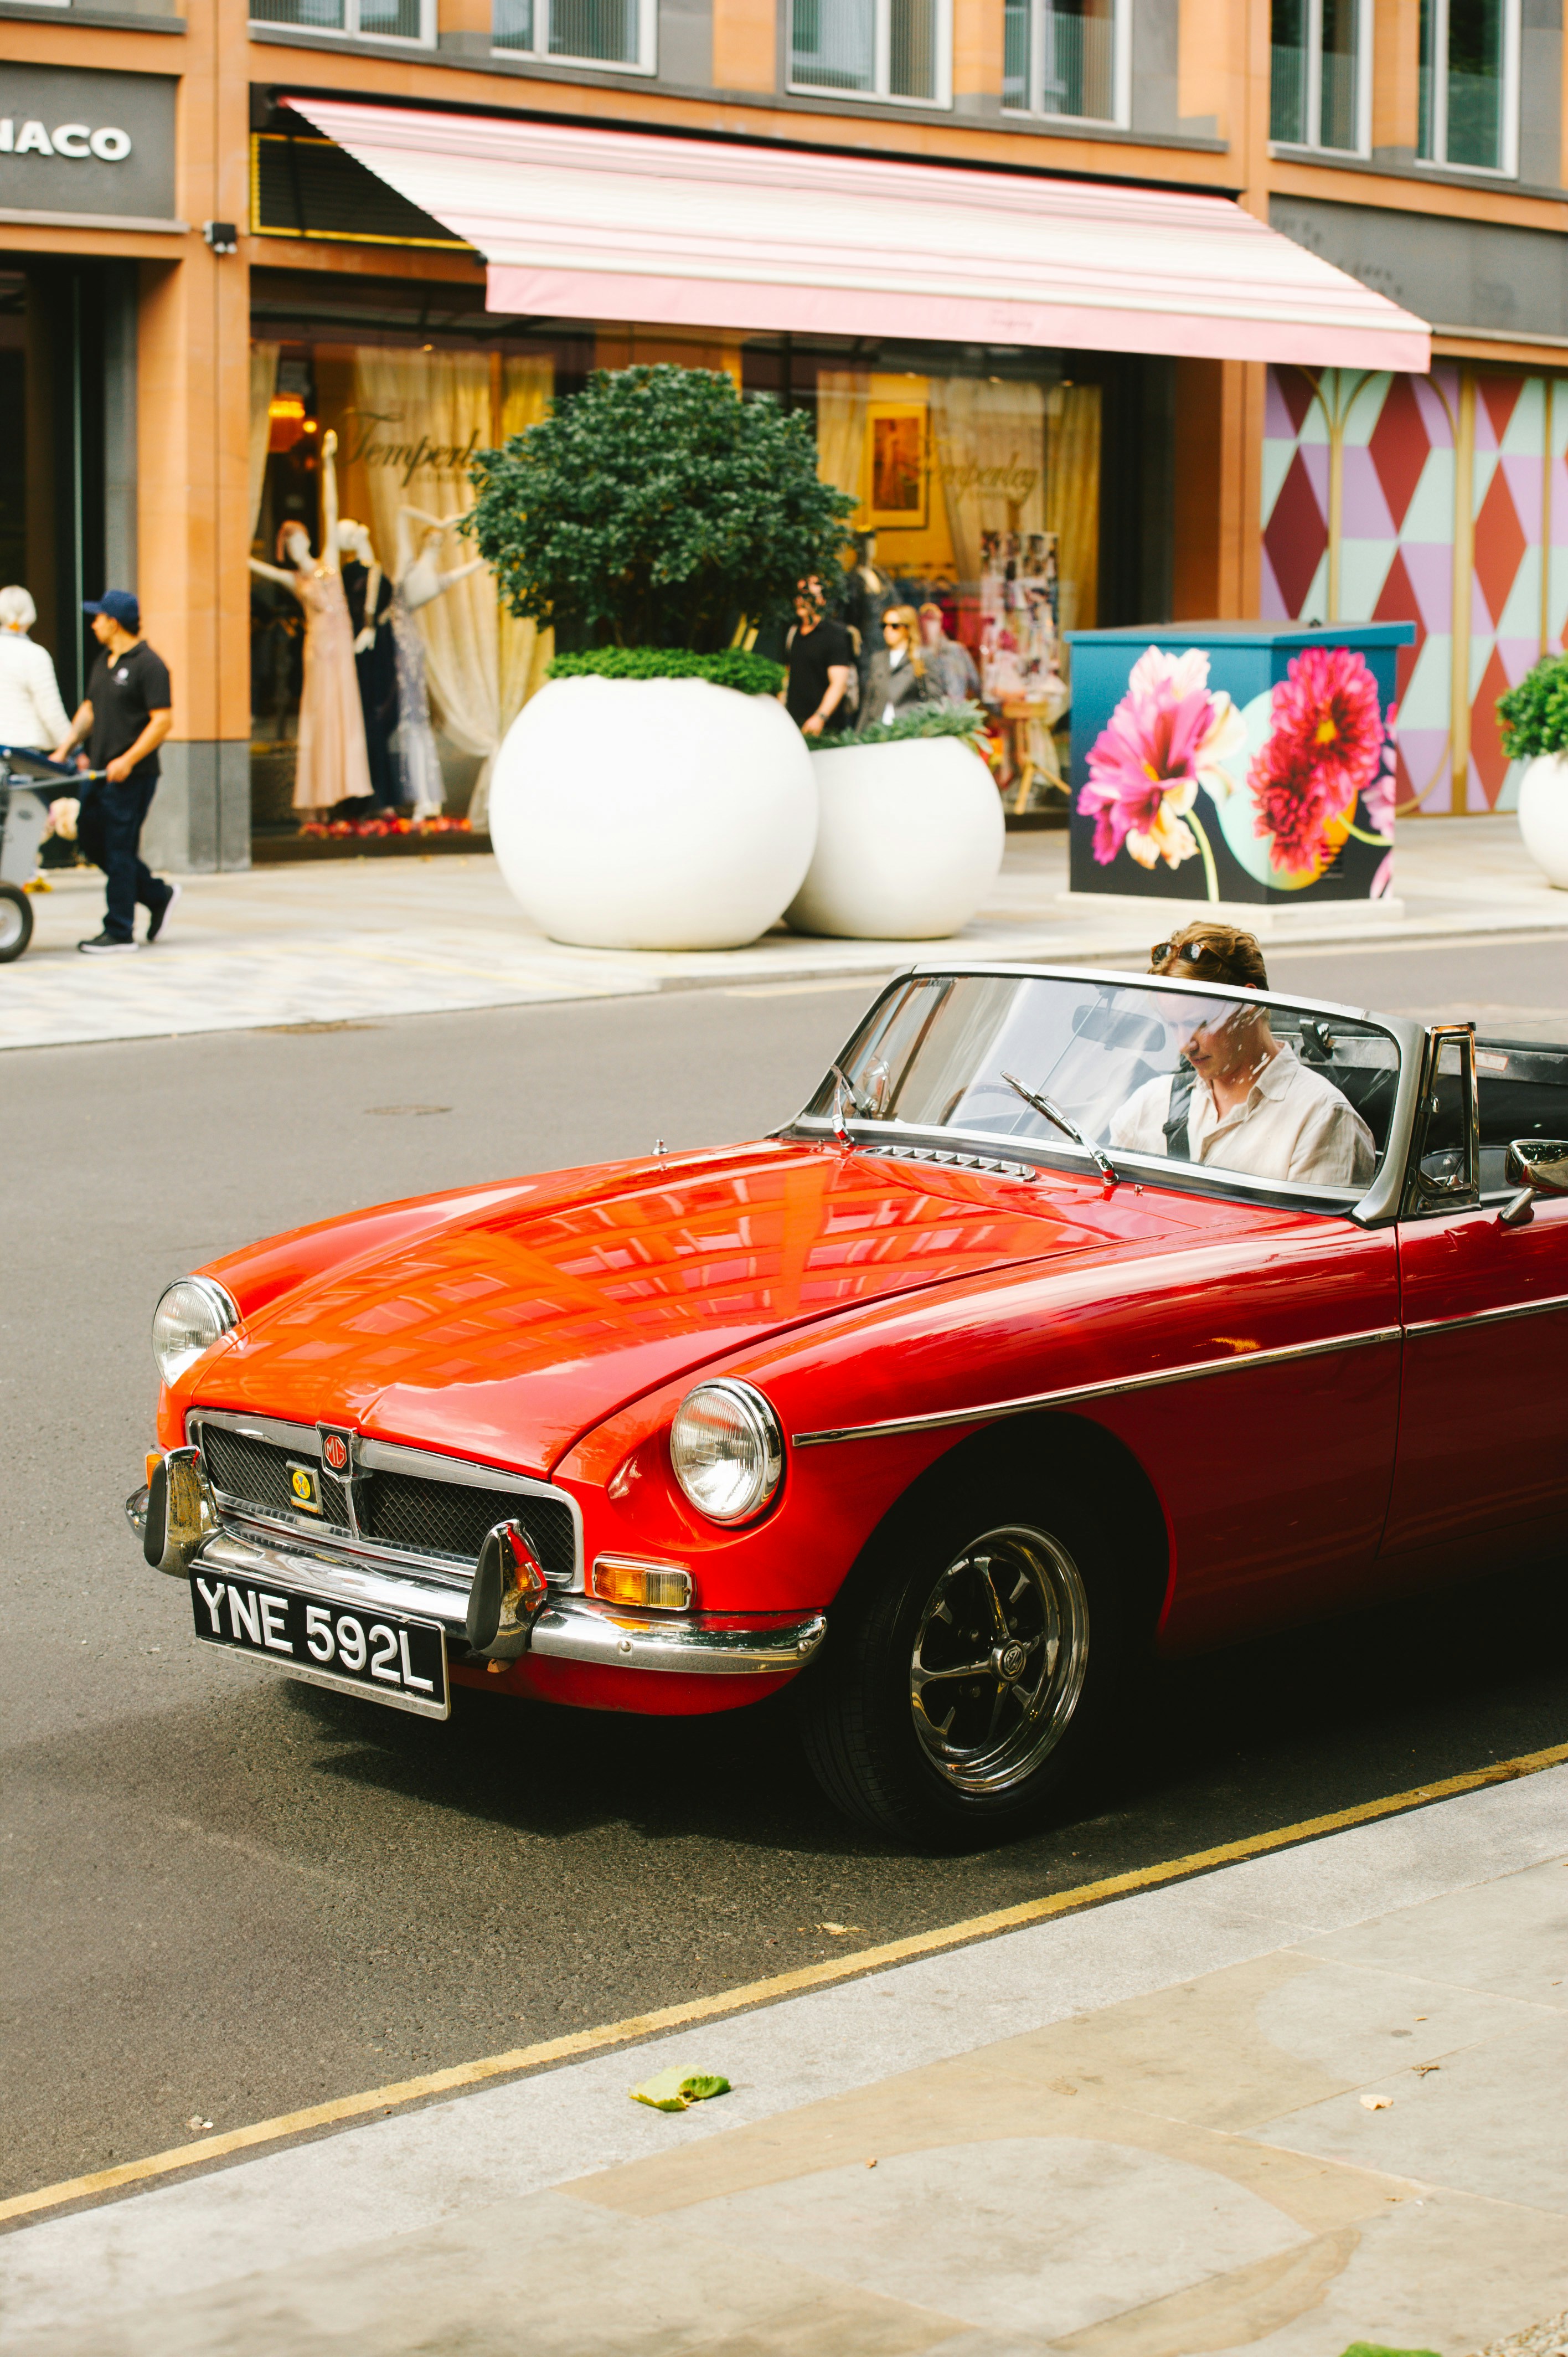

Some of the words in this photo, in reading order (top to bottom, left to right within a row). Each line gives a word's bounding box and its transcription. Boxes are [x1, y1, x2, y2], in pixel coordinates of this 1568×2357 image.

[336, 410, 479, 487] Temperl
[326, 1437, 345, 1465] MG
[196, 1577, 293, 1653] YNE
[306, 1605, 434, 1692] 592L
